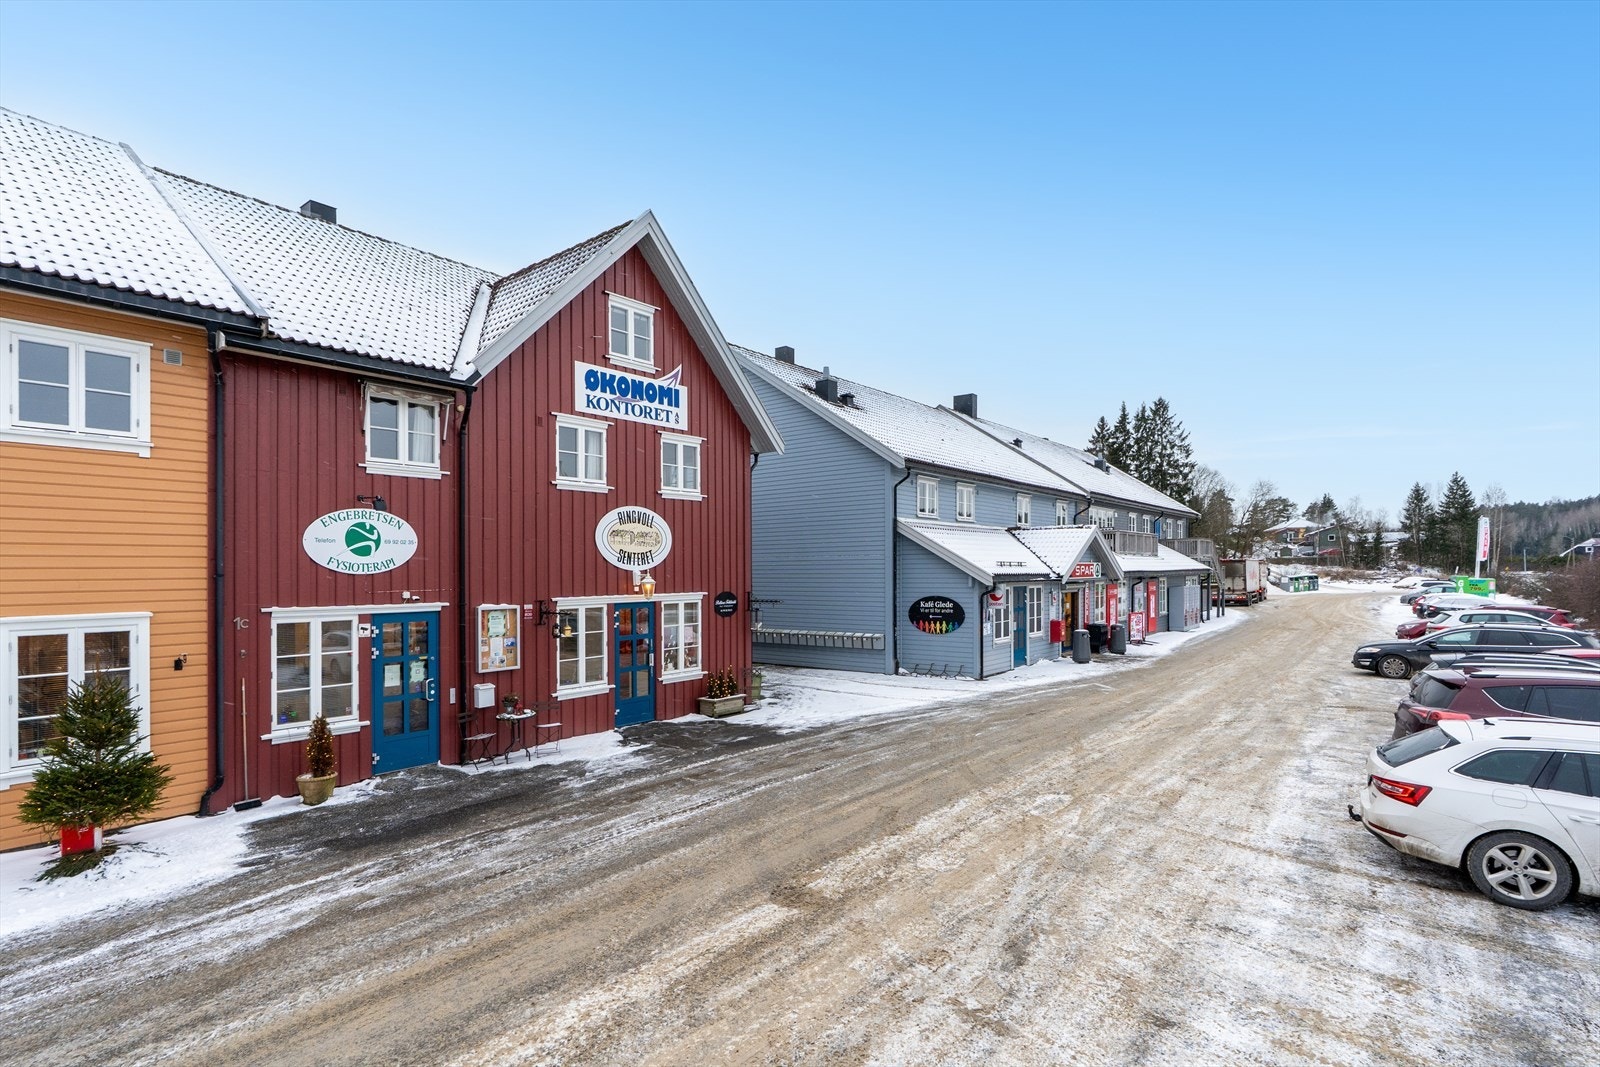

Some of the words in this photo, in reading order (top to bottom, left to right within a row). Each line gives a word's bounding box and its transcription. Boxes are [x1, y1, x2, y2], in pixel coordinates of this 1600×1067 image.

[584, 368, 680, 408] ØKONOMI
[585, 394, 673, 423] KONTORET
[320, 510, 404, 530] ENGEBRETSEN
[617, 510, 655, 529] RINGVOLL
[326, 556, 396, 573] FYSIOTERAPI
[617, 549, 654, 567] SENTERET
[1075, 565, 1094, 576] SPAR
